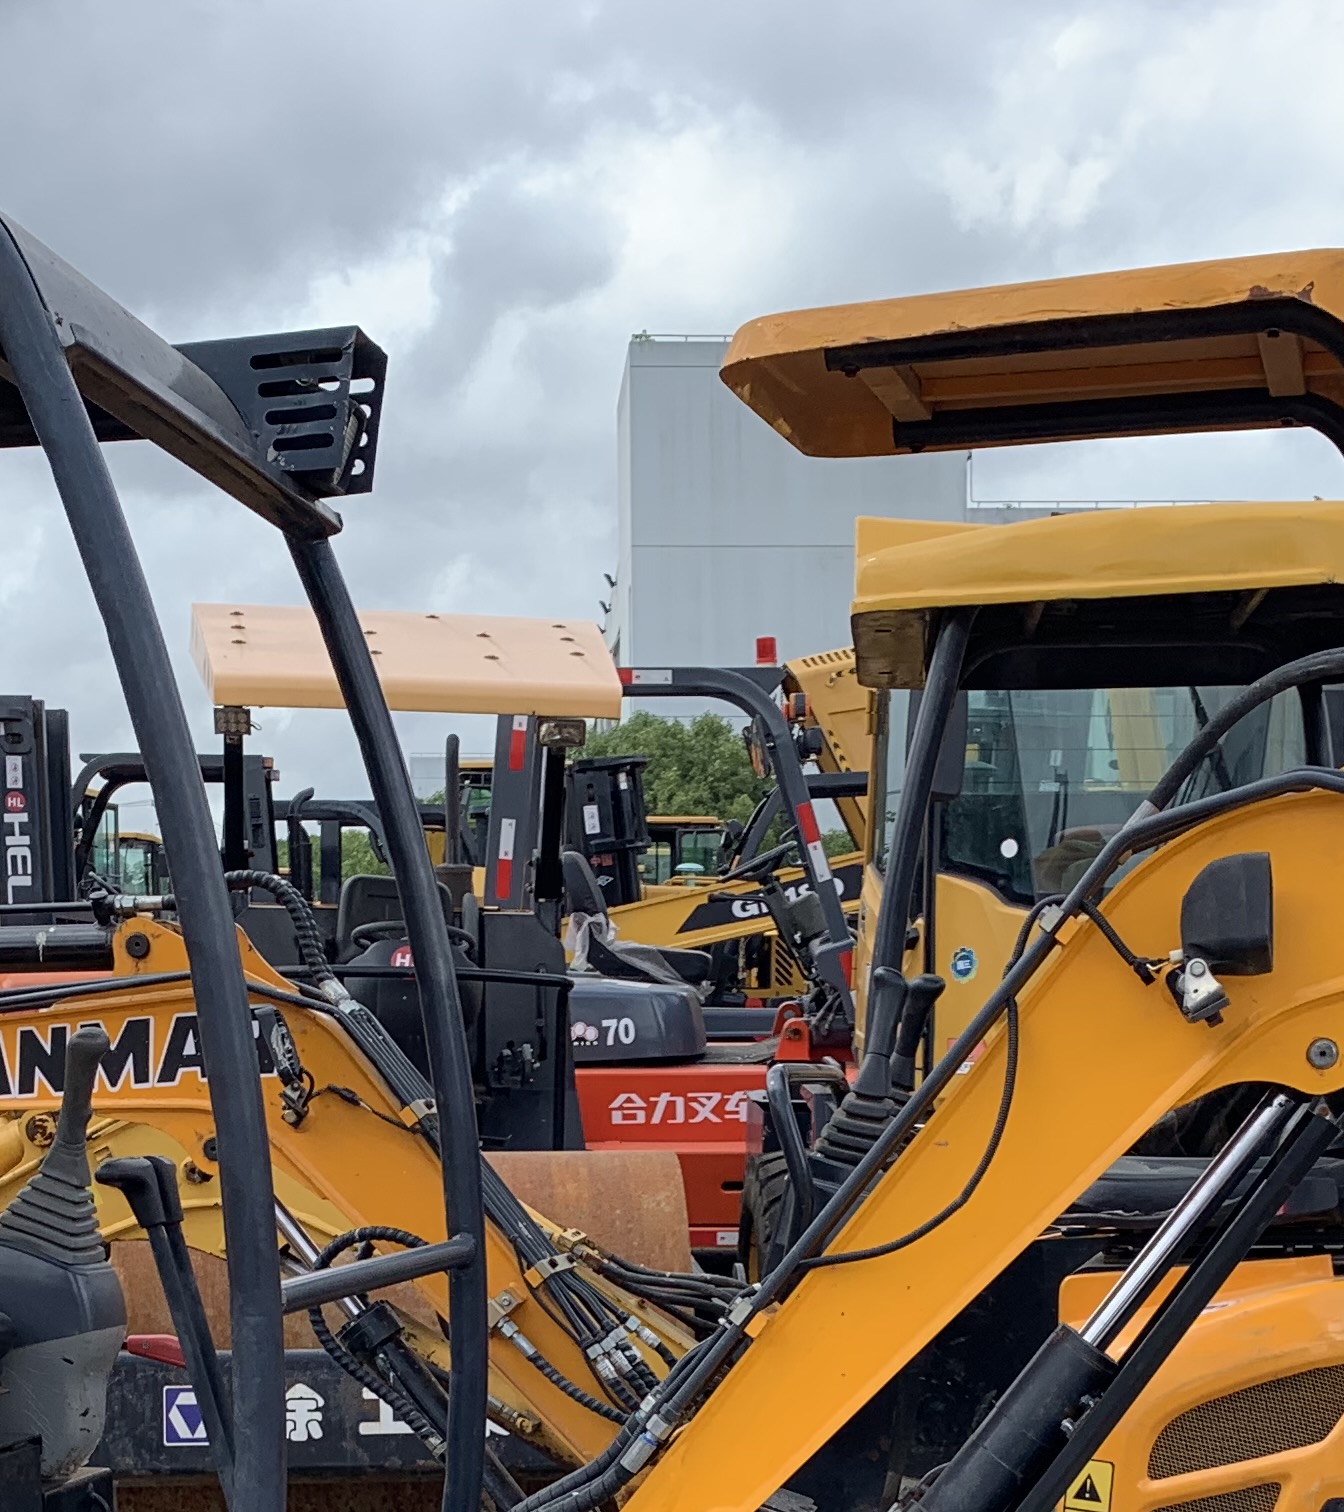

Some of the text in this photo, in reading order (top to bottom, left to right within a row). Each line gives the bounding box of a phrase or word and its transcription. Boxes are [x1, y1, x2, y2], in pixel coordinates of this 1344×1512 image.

[7, 797, 25, 808] HL
[3, 812, 33, 905] HEL
[601, 1017, 636, 1046] 70
